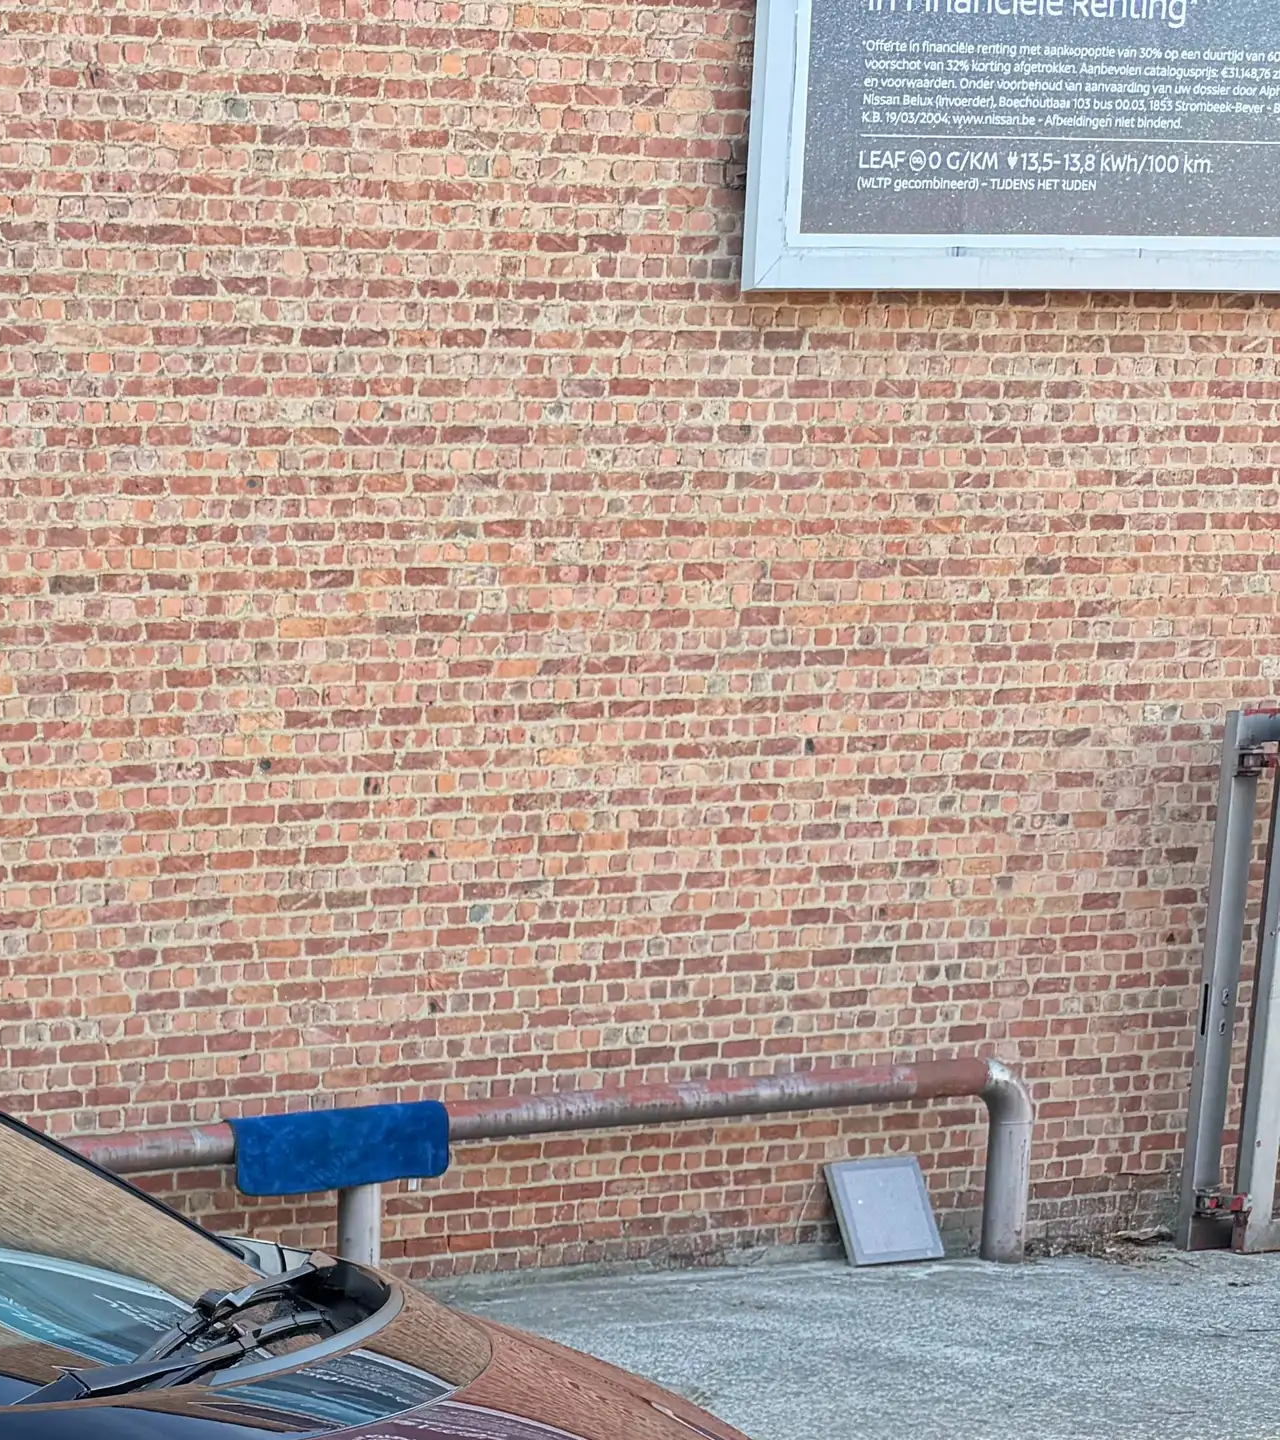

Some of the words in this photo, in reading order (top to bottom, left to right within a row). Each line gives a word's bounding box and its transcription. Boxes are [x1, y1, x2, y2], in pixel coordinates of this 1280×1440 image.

[909, 40, 920, 53] in
[923, 40, 974, 54] financiële
[977, 42, 1016, 58] renting
[1019, 43, 1041, 56] met
[1118, 49, 1137, 59] van
[1140, 46, 1162, 59] 30%
[1164, 50, 1178, 63] op
[1181, 51, 1201, 60] een
[1203, 48, 1243, 64] duurtijd
[1246, 52, 1265, 62] van
[865, 58, 922, 71] voorschot
[924, 62, 944, 72] van
[946, 60, 969, 73] 32%
[972, 60, 1010, 76] korting
[1080, 63, 1141, 77] Aanbevolen
[864, 78, 878, 88] en
[881, 76, 957, 89] voorwaarden.
[960, 77, 994, 90] Onder
[997, 78, 1063, 92] voorbehoud
[1065, 82, 1082, 92] van
[1085, 80, 1150, 96] aanvaarding
[1152, 84, 1172, 94] van
[1175, 85, 1190, 94] uw
[1193, 82, 1230, 95] dossier
[1233, 83, 1257, 95] door
[863, 92, 900, 105] Nissan
[903, 93, 933, 106] Belux
[1073, 97, 1090, 110] 103
[1093, 98, 1113, 110] bus
[1149, 99, 1173, 112] 1853
[1175, 100, 1265, 114] Strombeek-Bever
[953, 112, 1036, 126] www.nissan.be
[1045, 113, 1113, 130] Afbeeldingen
[1115, 115, 1135, 127] niet
[1137, 115, 1183, 128] bindend.
[858, 150, 906, 169] LEAF
[929, 151, 941, 170] 0
[946, 151, 998, 173] G/KM
[1038, 178, 1059, 190] HET
